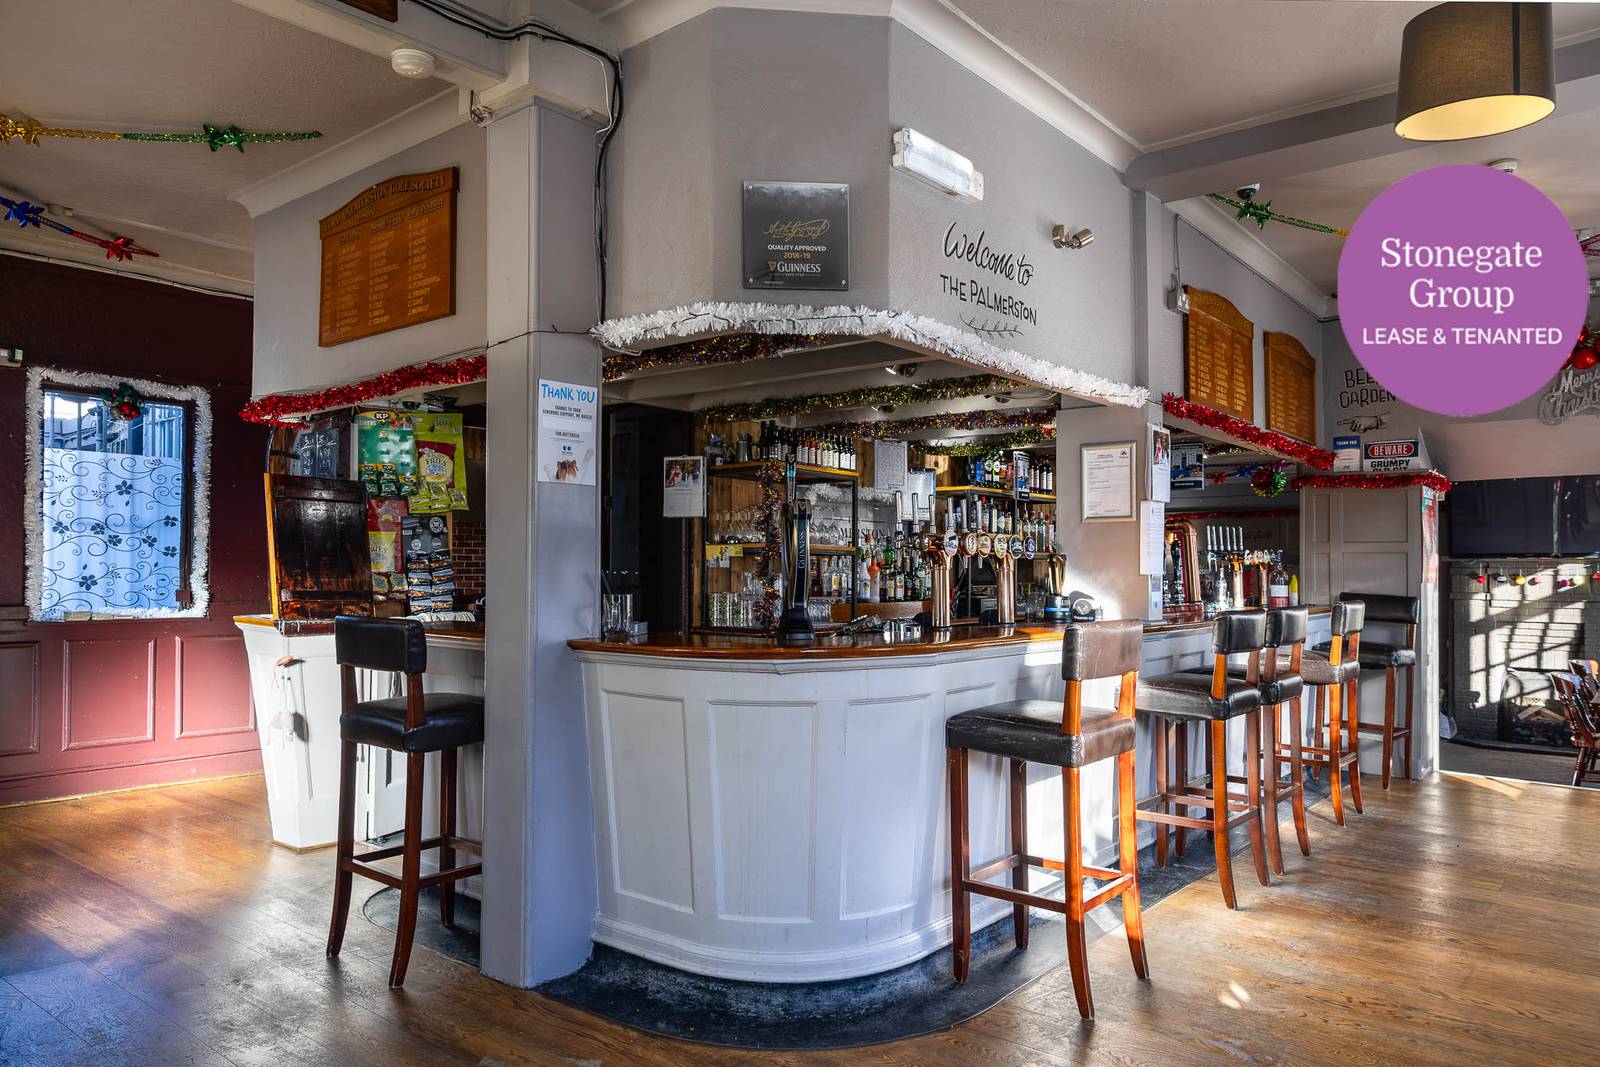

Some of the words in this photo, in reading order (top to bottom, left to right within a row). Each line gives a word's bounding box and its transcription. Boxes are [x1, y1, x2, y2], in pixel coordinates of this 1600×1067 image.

[944, 222, 1014, 280] Welcome
[1017, 254, 1034, 286] to
[777, 261, 821, 273] GUINNESS
[940, 274, 967, 302] THE
[970, 280, 1037, 326] PALMERSTON
[1344, 367, 1379, 389] BEE
[541, 383, 574, 401] THANK
[576, 389, 595, 404] YOU
[376, 412, 389, 420] KP
[1374, 444, 1408, 456] BEWARE
[1371, 459, 1410, 468] GRUMPY
